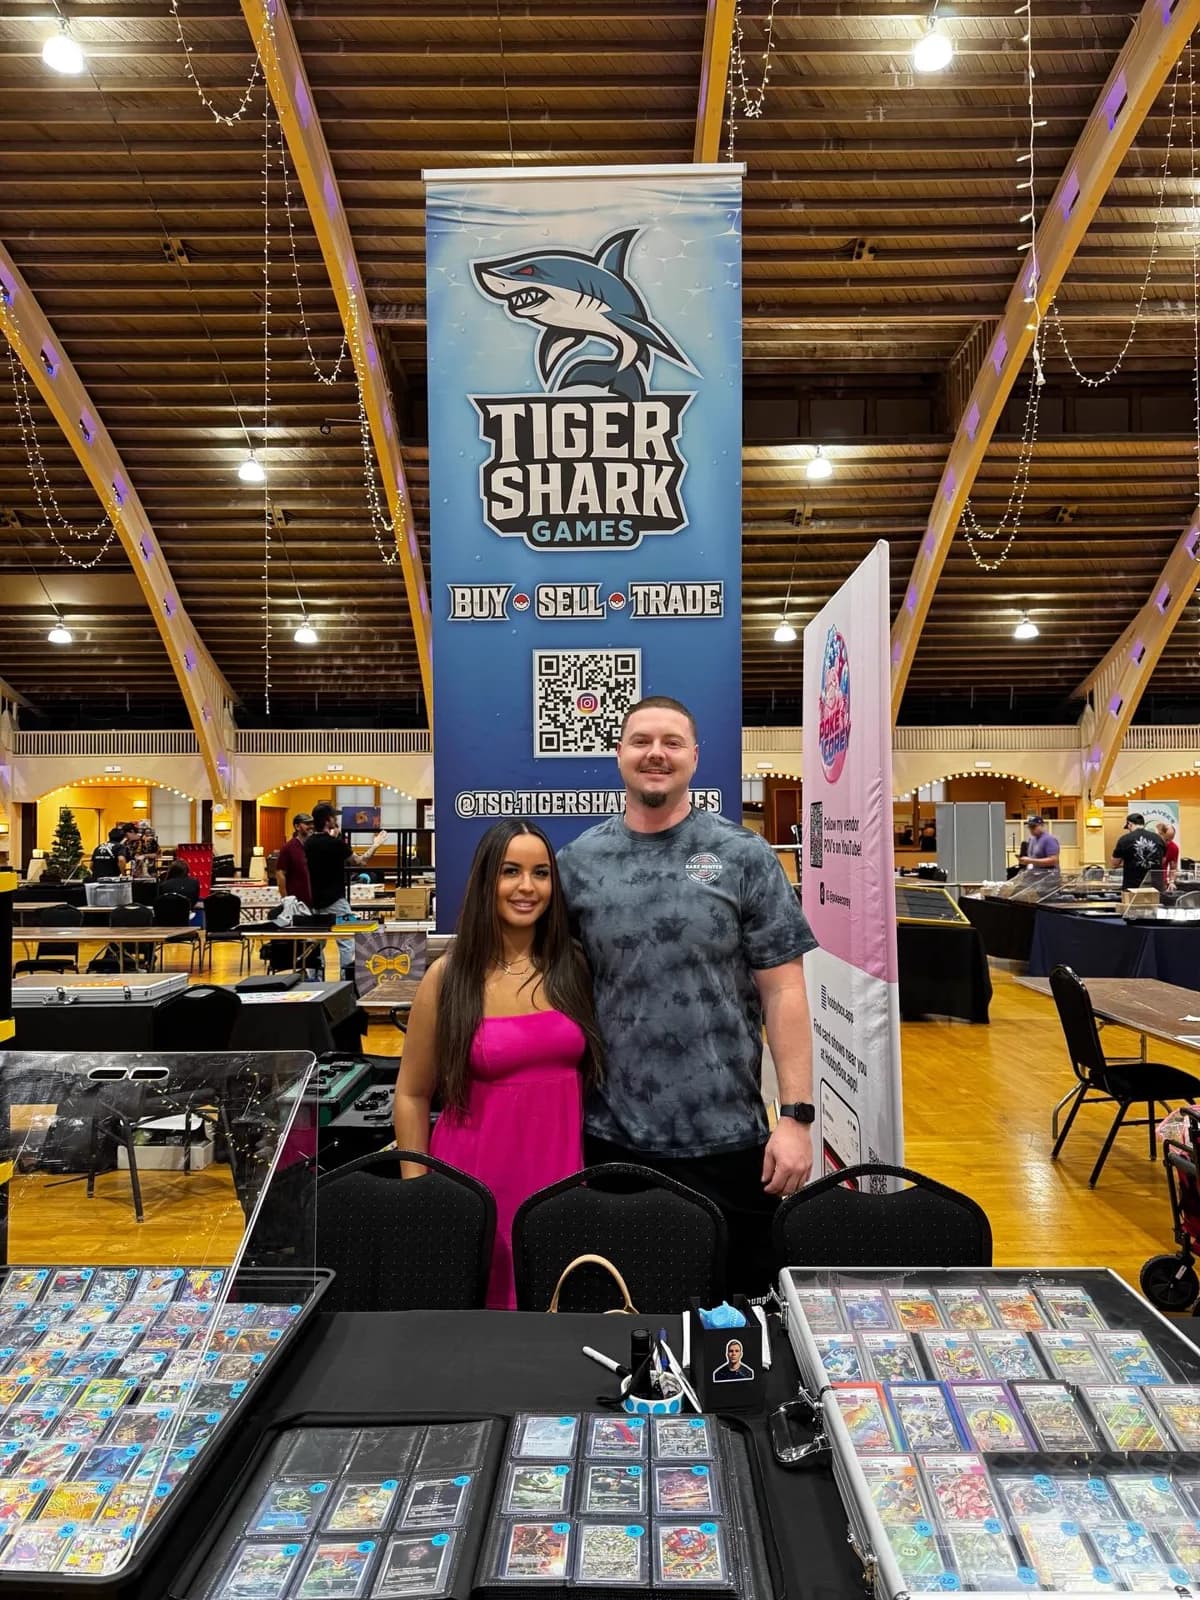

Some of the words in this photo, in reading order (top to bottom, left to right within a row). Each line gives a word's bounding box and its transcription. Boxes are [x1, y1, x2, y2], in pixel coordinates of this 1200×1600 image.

[486, 401, 671, 462] TIGER
[490, 463, 678, 520] SHARK
[531, 520, 635, 543] GAMES
[452, 586, 512, 617] BUY
[538, 585, 604, 617] SELL
[630, 584, 722, 616] TRADE
